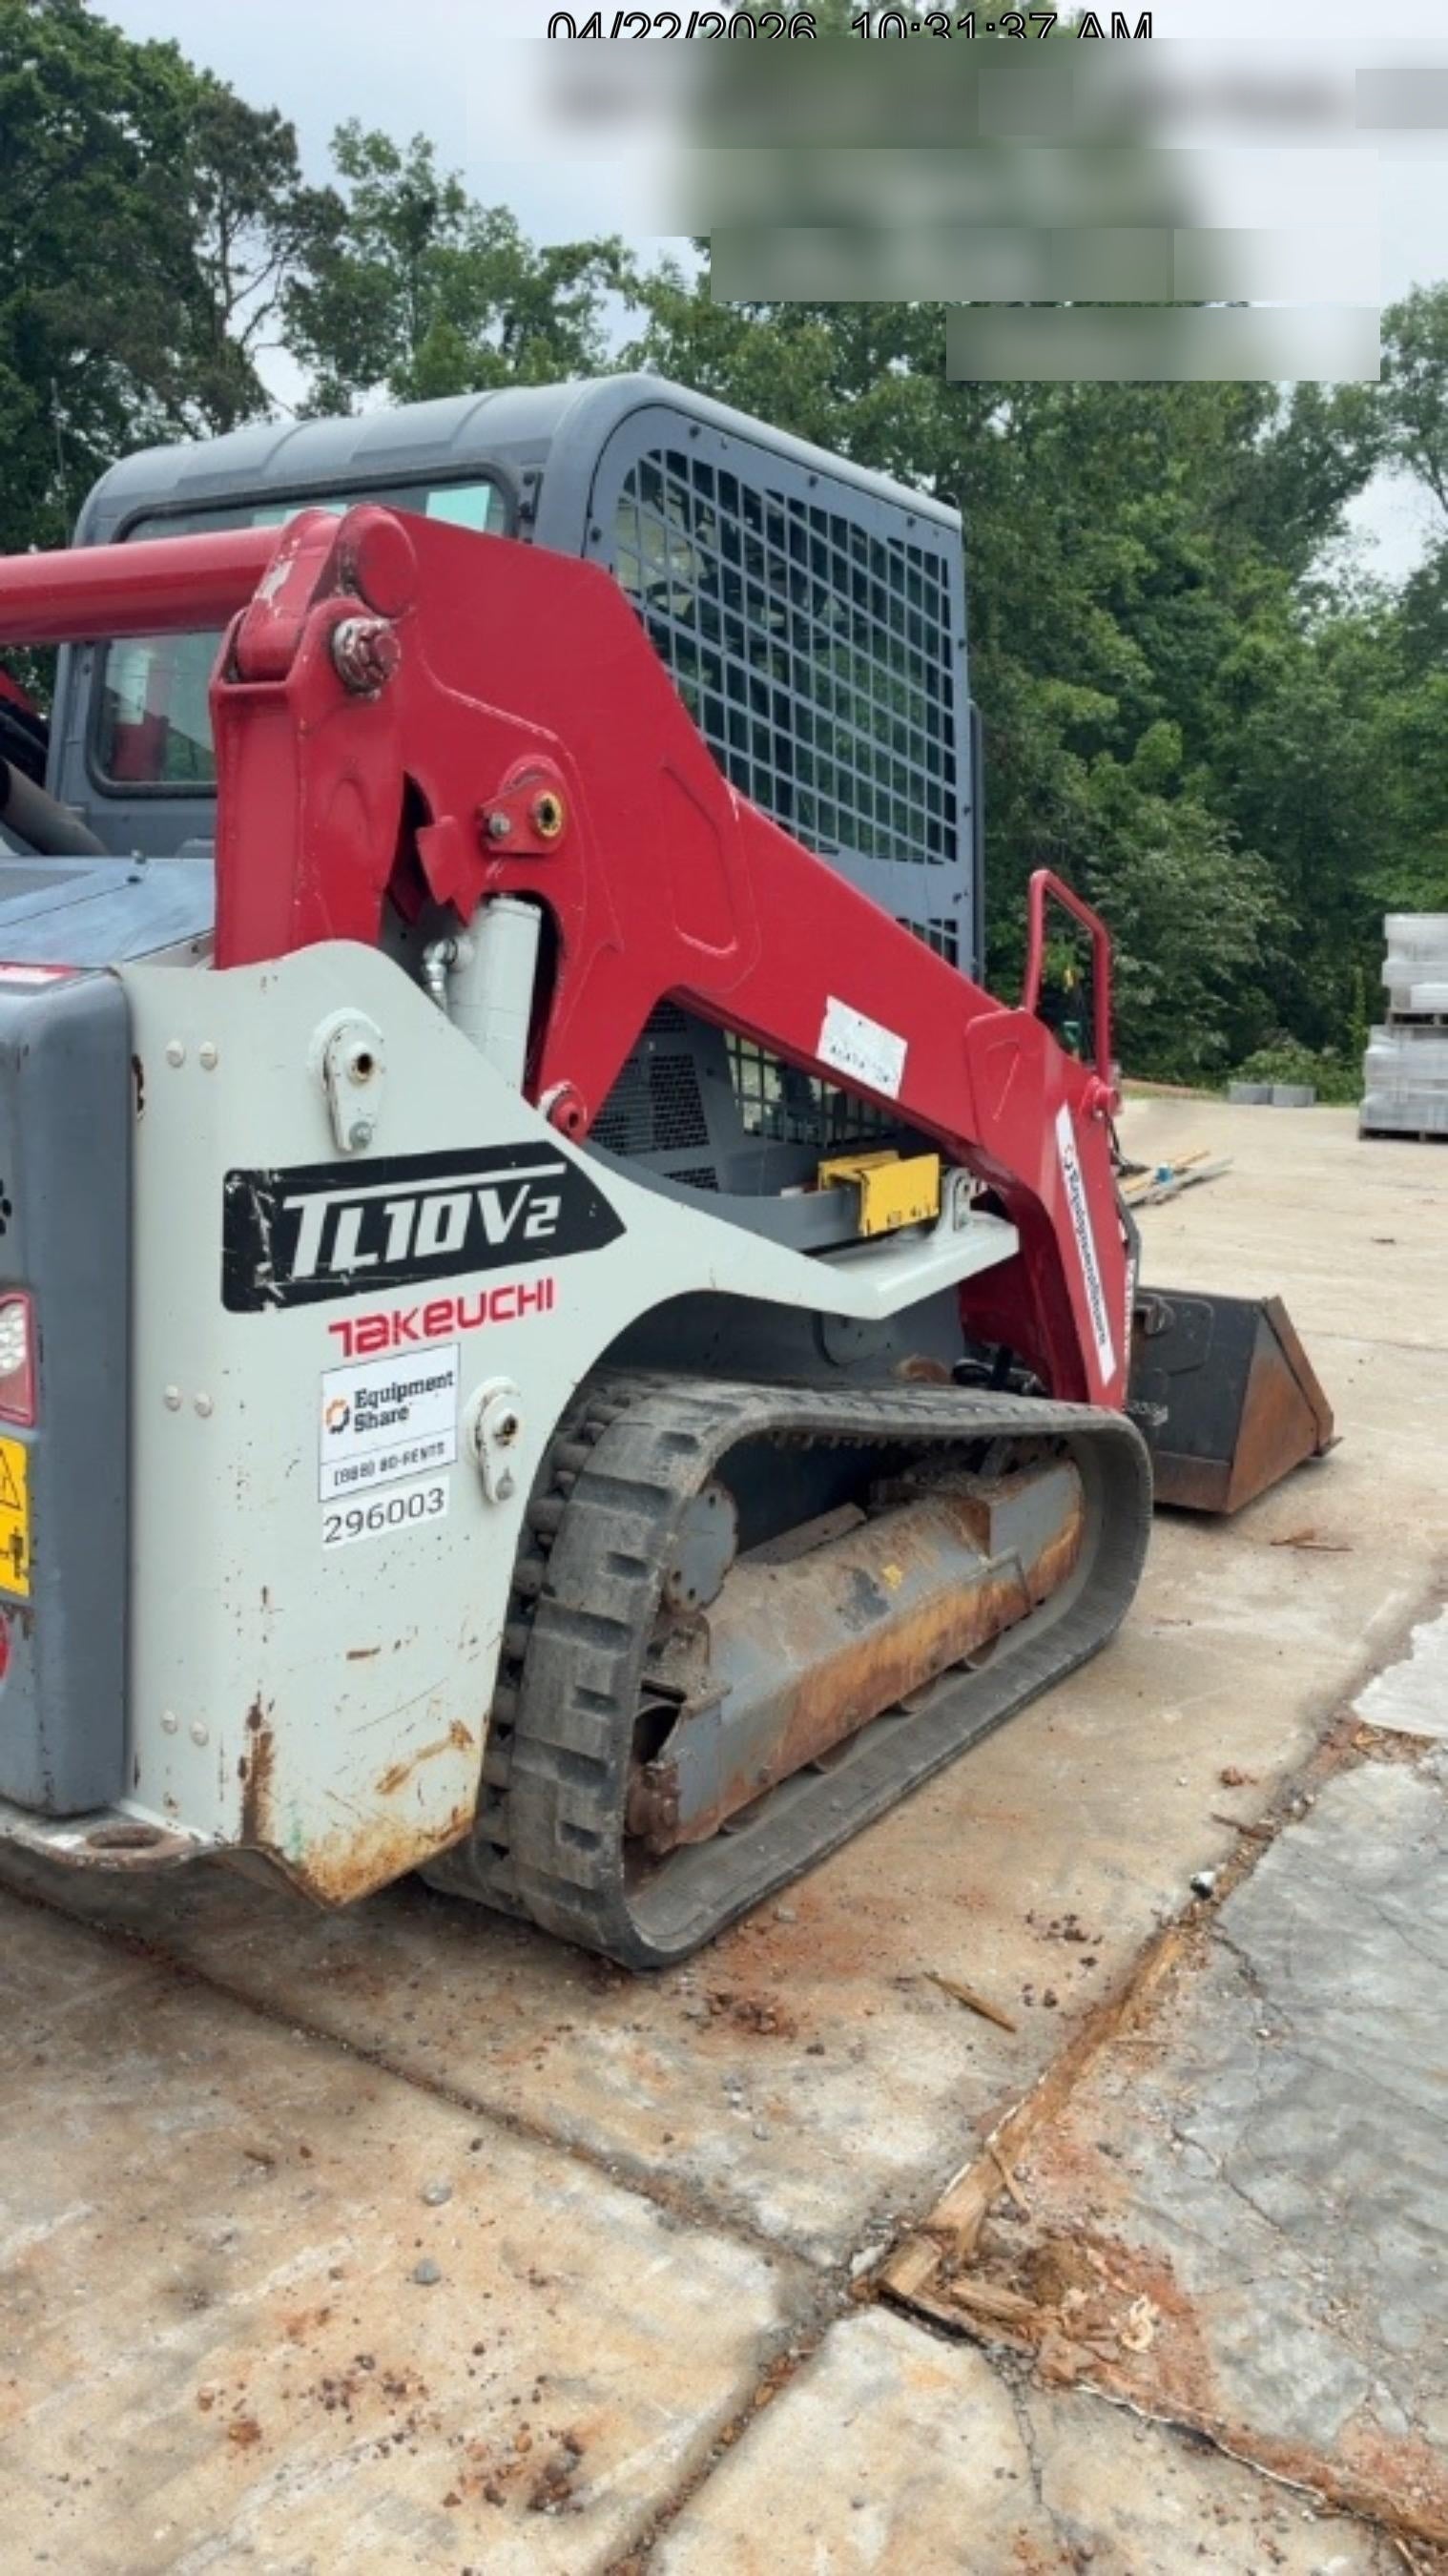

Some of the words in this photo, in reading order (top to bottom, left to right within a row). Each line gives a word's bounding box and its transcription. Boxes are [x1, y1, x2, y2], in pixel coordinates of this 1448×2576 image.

[283, 1163, 566, 1278] TL10V2
[354, 1370, 453, 1409] Equipment
[354, 1406, 409, 1433] Share
[323, 1487, 445, 1544] 296003
